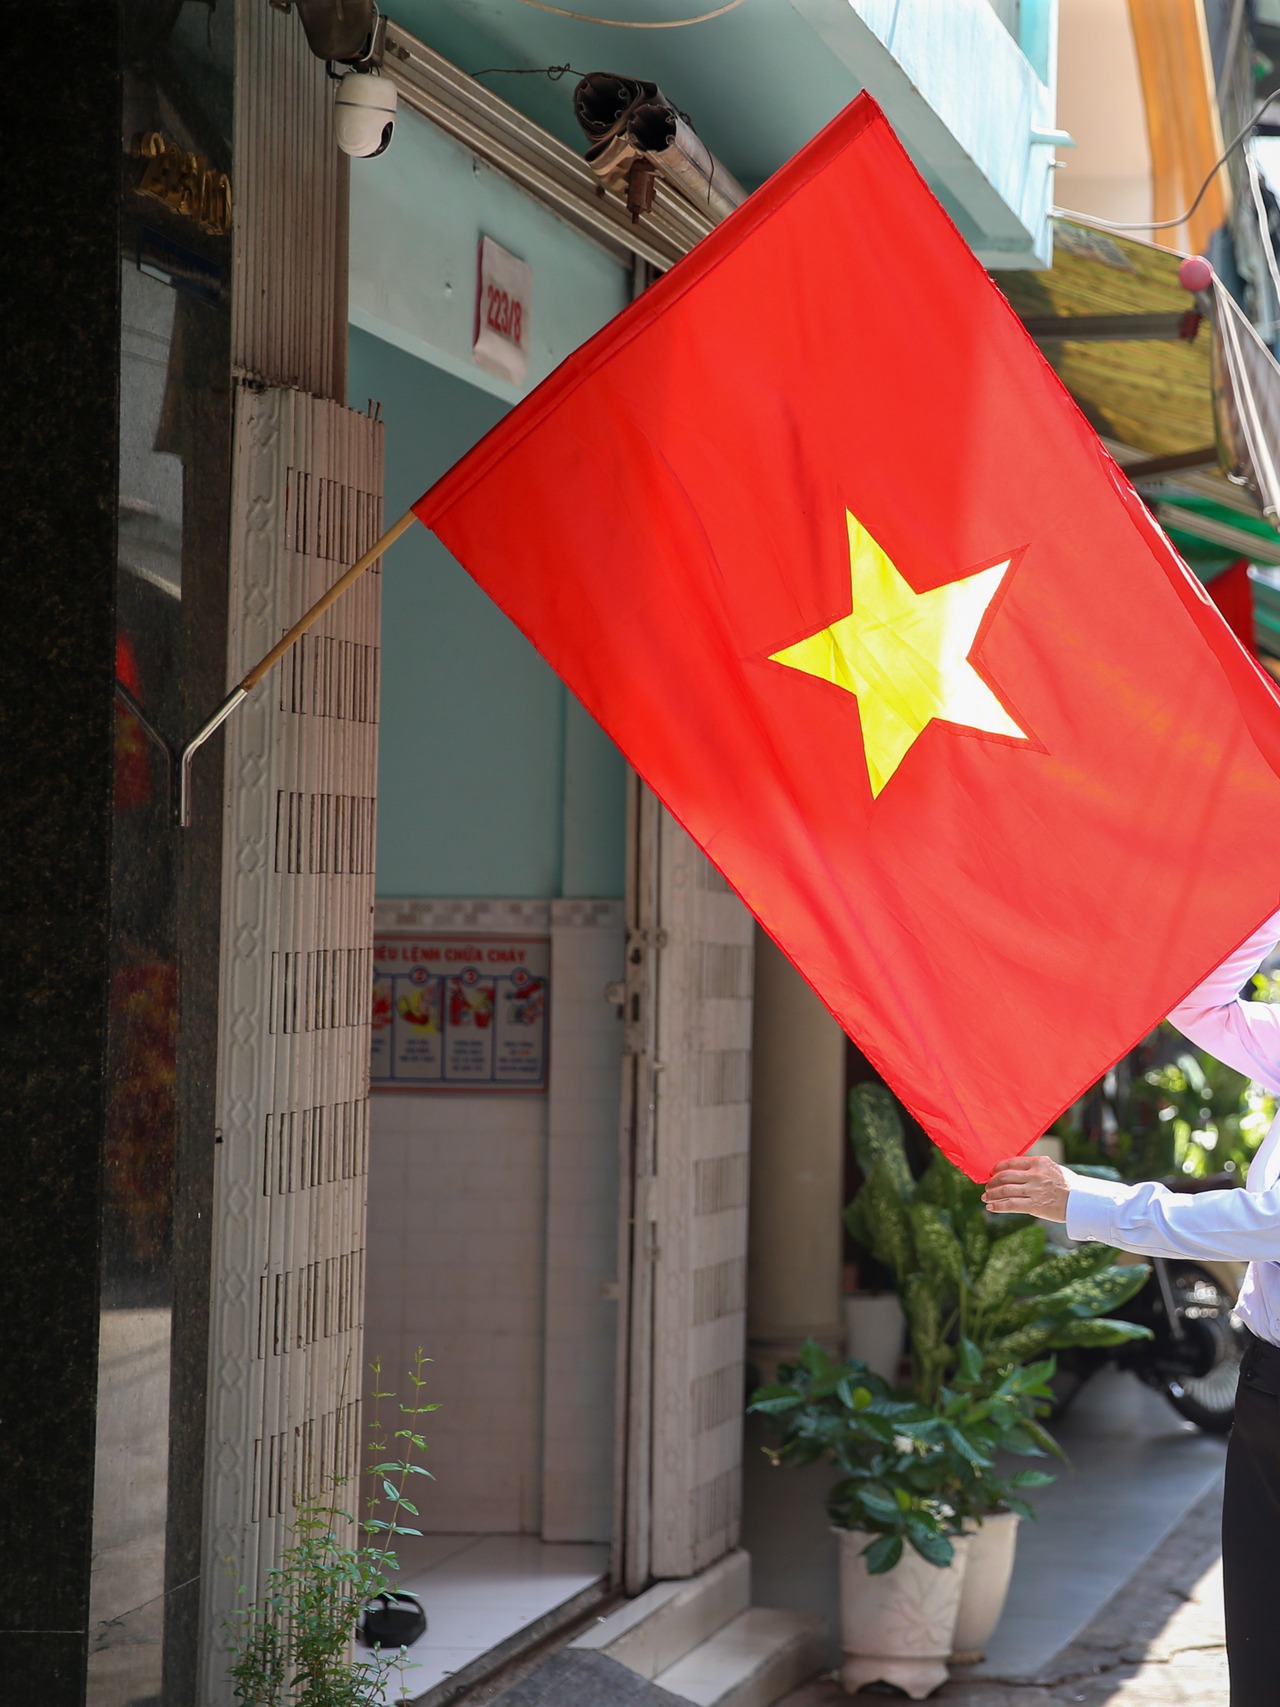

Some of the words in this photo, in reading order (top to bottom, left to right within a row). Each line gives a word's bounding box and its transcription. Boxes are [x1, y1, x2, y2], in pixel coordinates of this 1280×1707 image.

[487, 284, 522, 343] 223/8
[374, 944, 398, 961] IÊU
[402, 944, 441, 962] LỆNH
[444, 945, 484, 962] CHỮA
